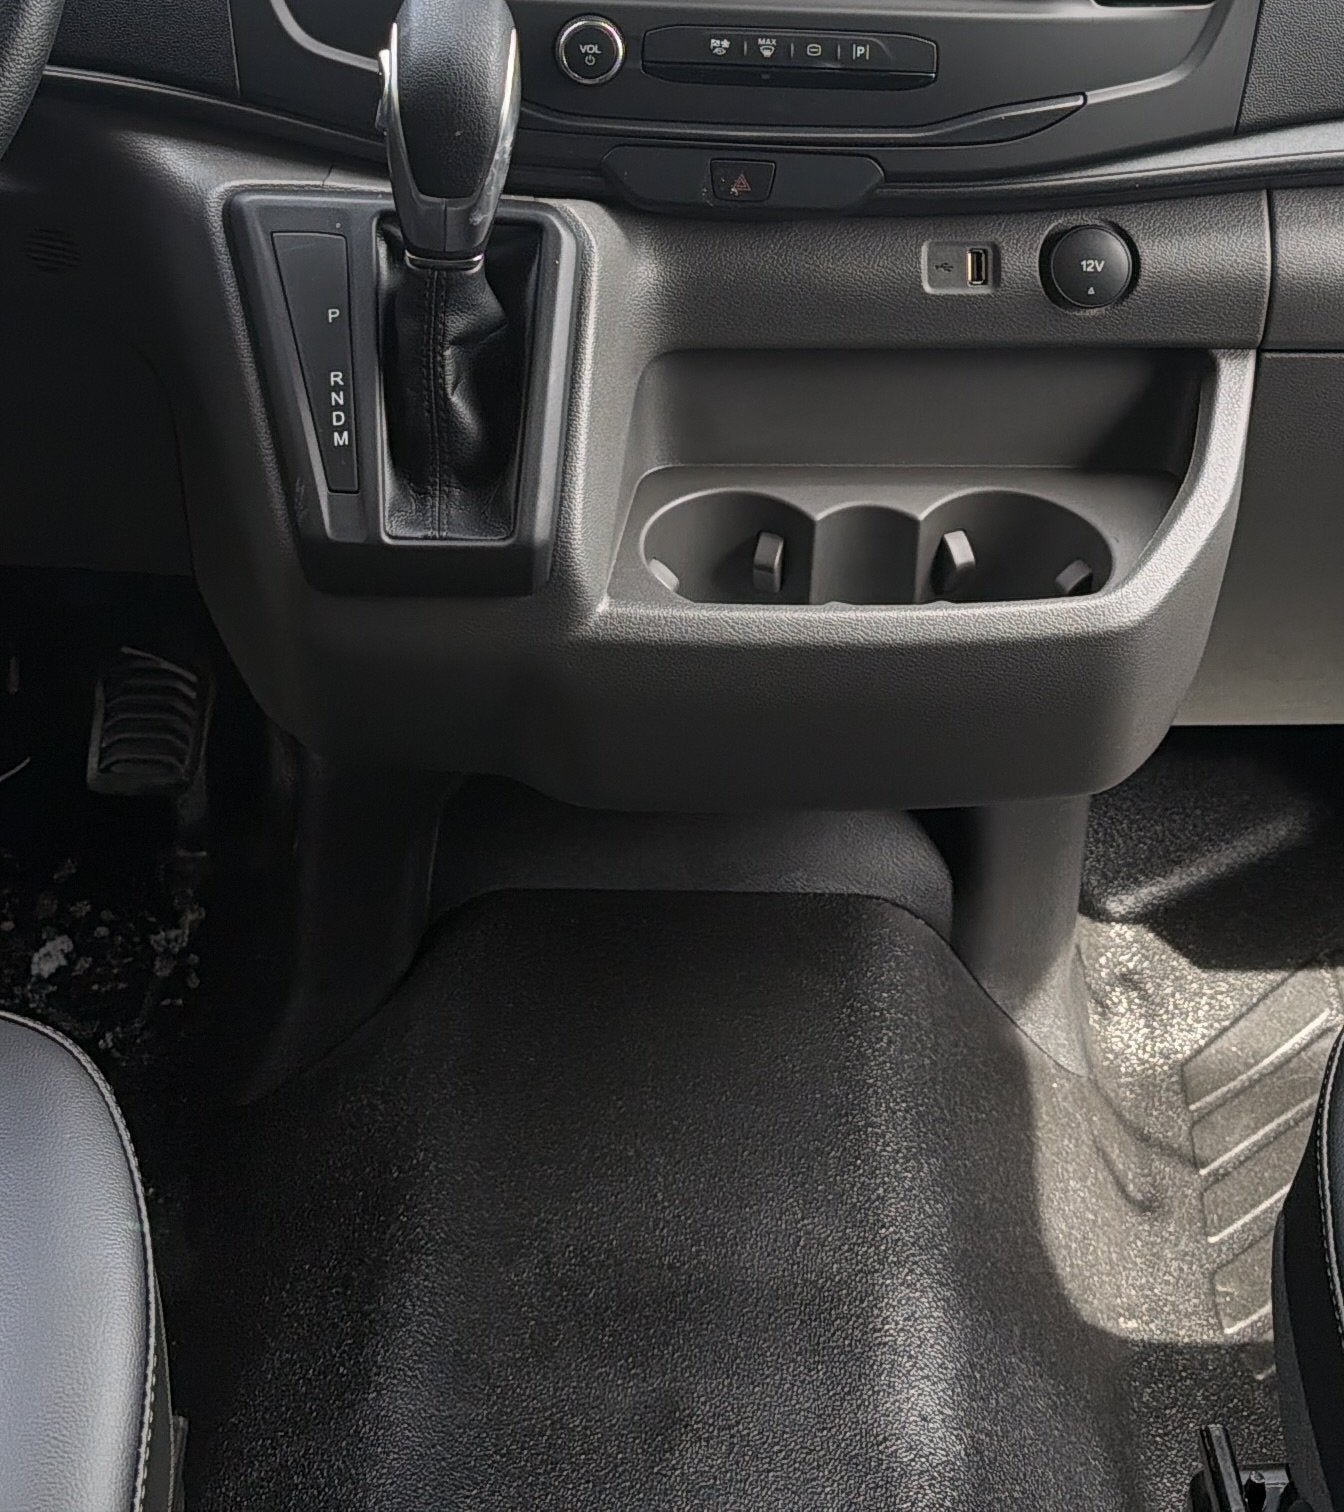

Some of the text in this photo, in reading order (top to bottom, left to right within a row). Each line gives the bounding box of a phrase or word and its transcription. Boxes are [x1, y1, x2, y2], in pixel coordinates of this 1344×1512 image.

[579, 43, 602, 55] VOL
[757, 38, 777, 46] MAX
[1080, 259, 1106, 273] 12V
[328, 308, 340, 323] P
[330, 371, 344, 386] R
[331, 391, 344, 406] N
[332, 411, 345, 426] D
[333, 430, 349, 446] M
